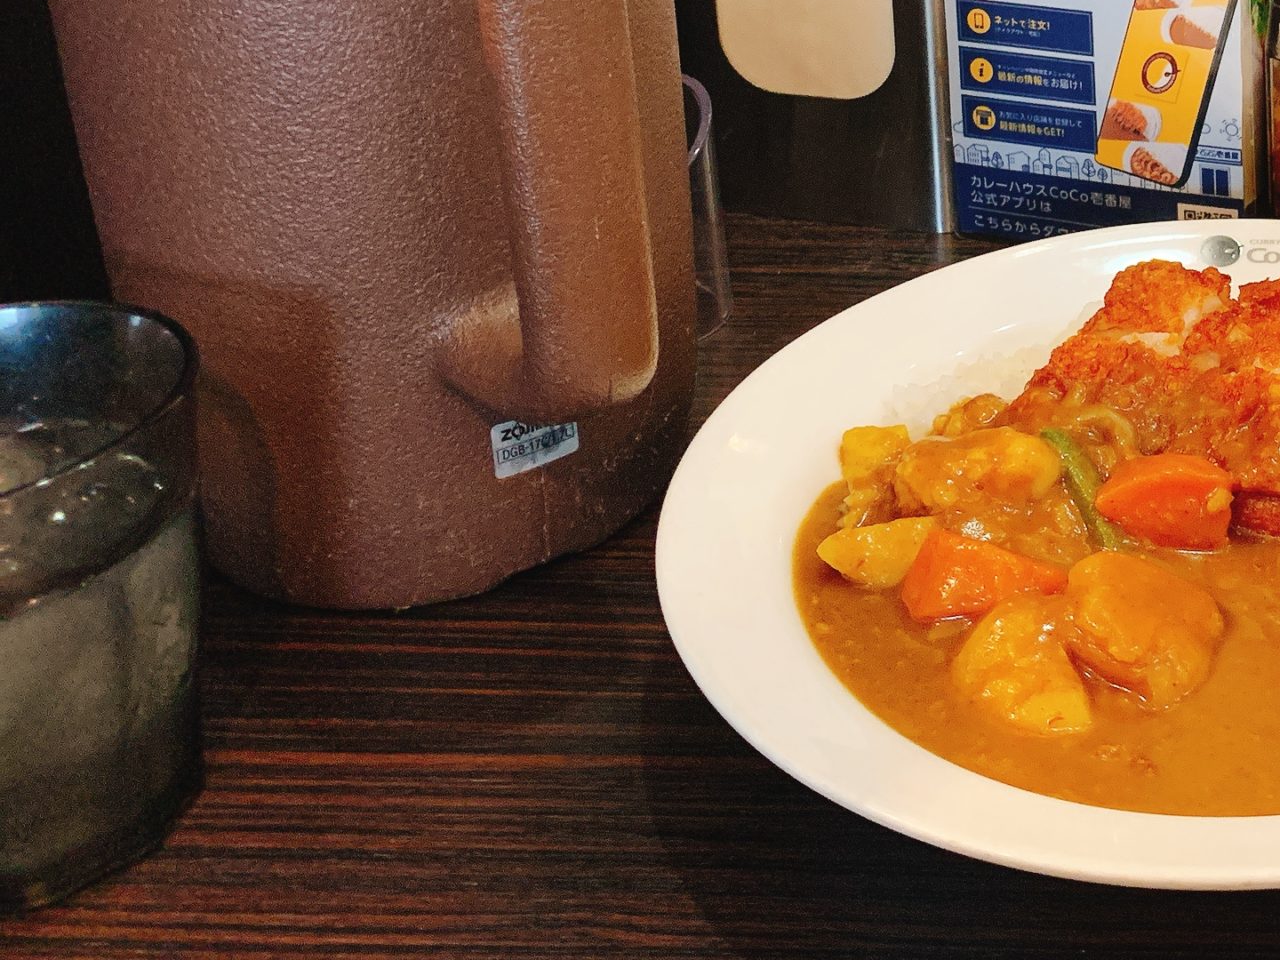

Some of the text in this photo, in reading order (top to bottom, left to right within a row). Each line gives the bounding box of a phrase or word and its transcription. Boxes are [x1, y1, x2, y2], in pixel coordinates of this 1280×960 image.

[970, 175, 1132, 209] カレーハウスCoCo壱番屋
[971, 190, 1052, 213] 公式アプリは
